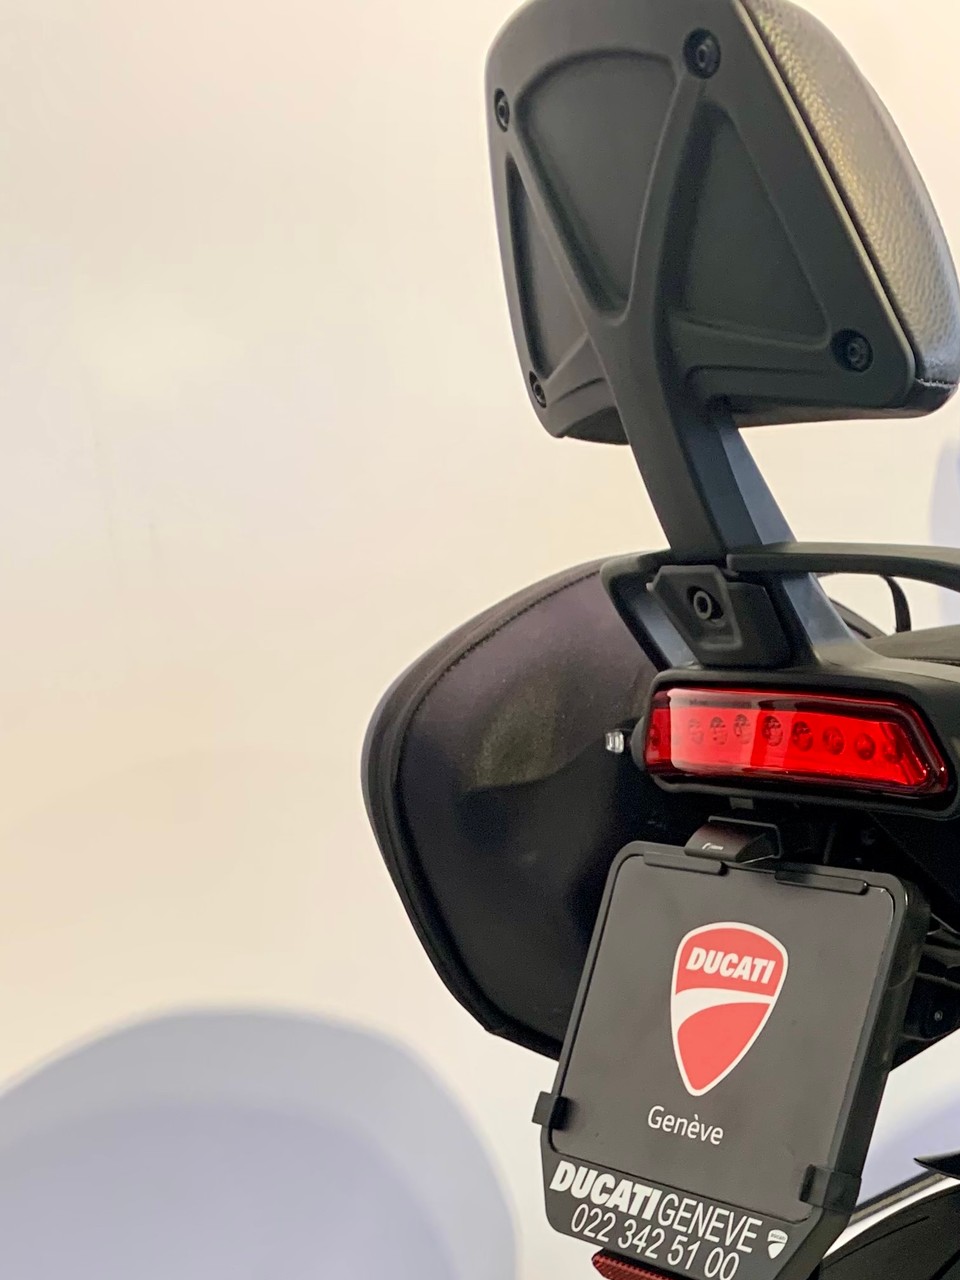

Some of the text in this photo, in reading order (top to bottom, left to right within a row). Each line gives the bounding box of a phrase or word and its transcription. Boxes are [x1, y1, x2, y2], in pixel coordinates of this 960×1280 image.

[685, 946, 776, 985] DUCATI
[646, 1105, 724, 1146] Genève
[571, 1203, 616, 1243] 022
[617, 1218, 665, 1259] 342
[667, 1234, 701, 1270] 51
